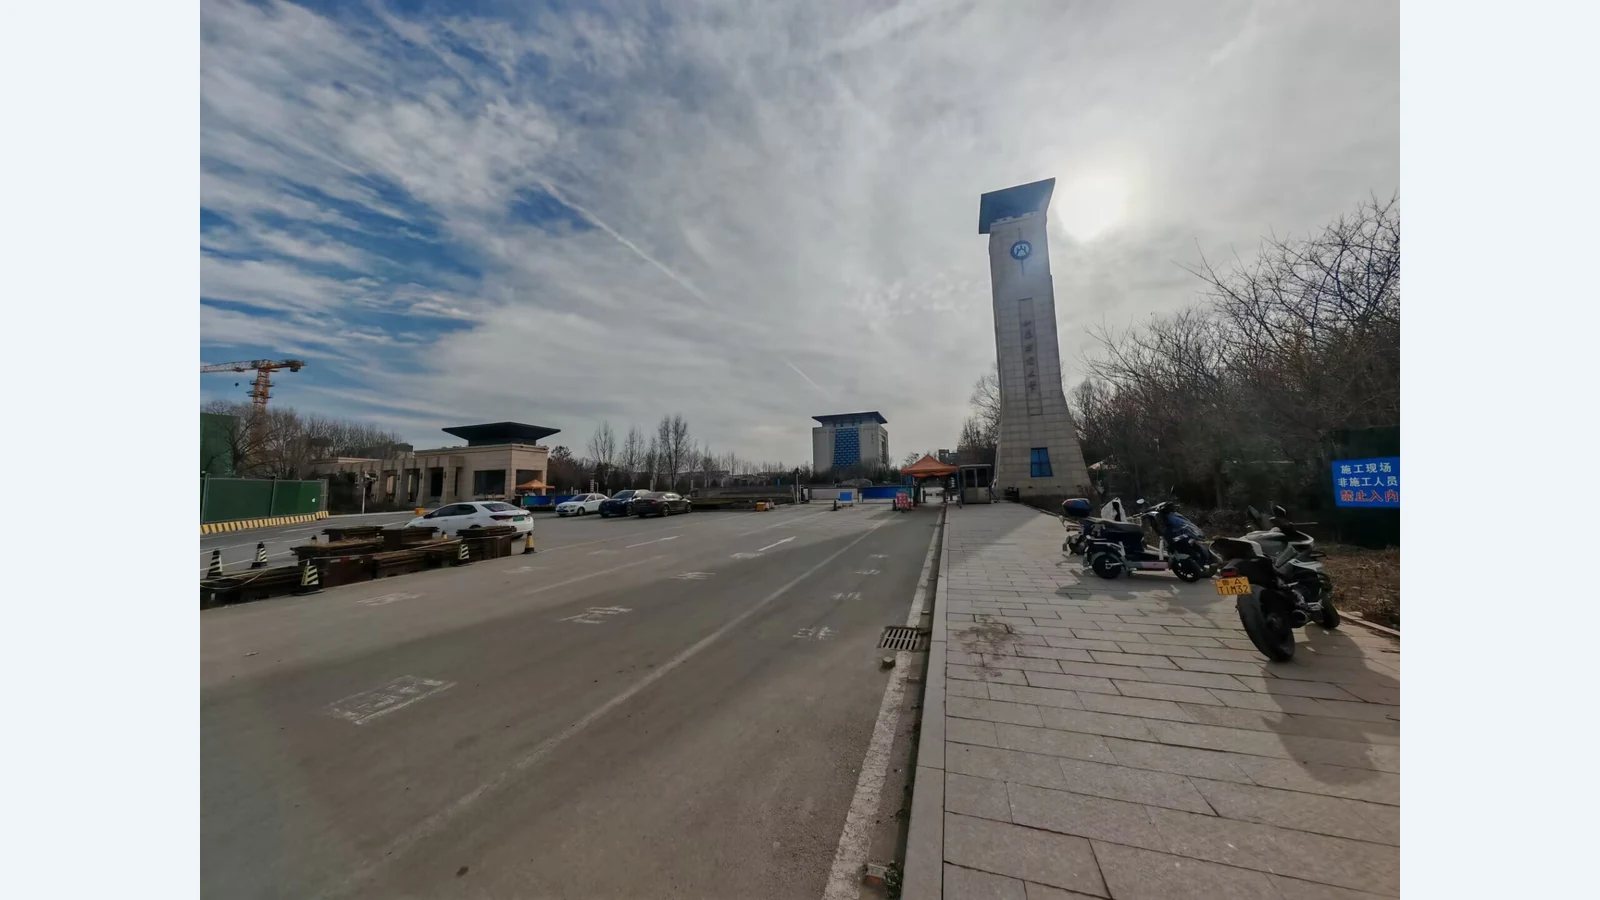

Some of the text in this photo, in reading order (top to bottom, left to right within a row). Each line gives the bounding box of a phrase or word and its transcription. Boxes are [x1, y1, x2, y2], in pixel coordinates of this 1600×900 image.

[1340, 462, 1392, 474] 施工现场
[1338, 476, 1398, 487] 非施工人员
[1341, 489, 1399, 503] 禁止入内
